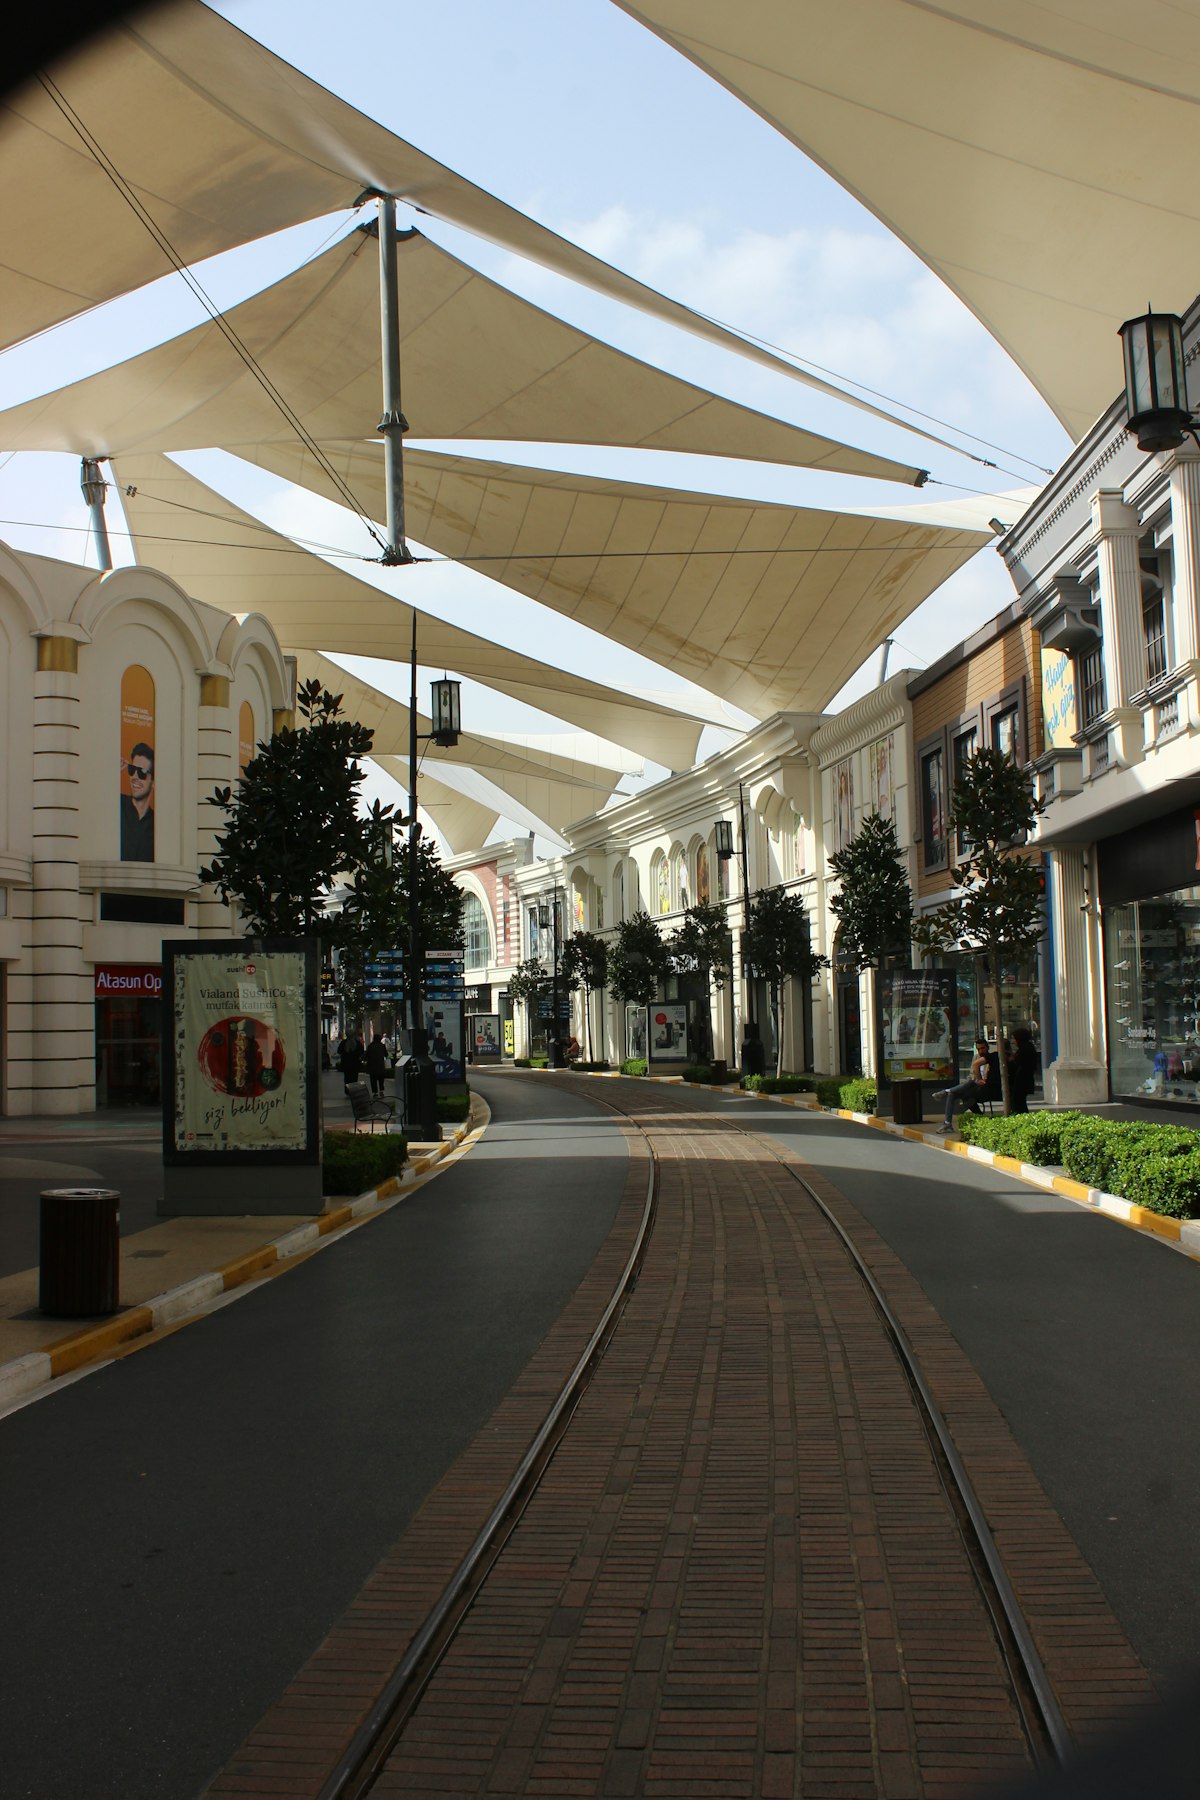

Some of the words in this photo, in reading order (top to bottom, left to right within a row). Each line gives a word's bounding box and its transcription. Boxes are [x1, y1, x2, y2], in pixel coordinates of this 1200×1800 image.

[97, 972, 141, 988] Atasun
[144, 973, 162, 992] Op
[200, 988, 240, 999] Vialand
[243, 988, 286, 999] SushiCo
[206, 1000, 239, 1010] mutfak
[242, 1000, 278, 1010] katında
[205, 1106, 225, 1131] sizi
[232, 1092, 287, 1125] bekliyor!
